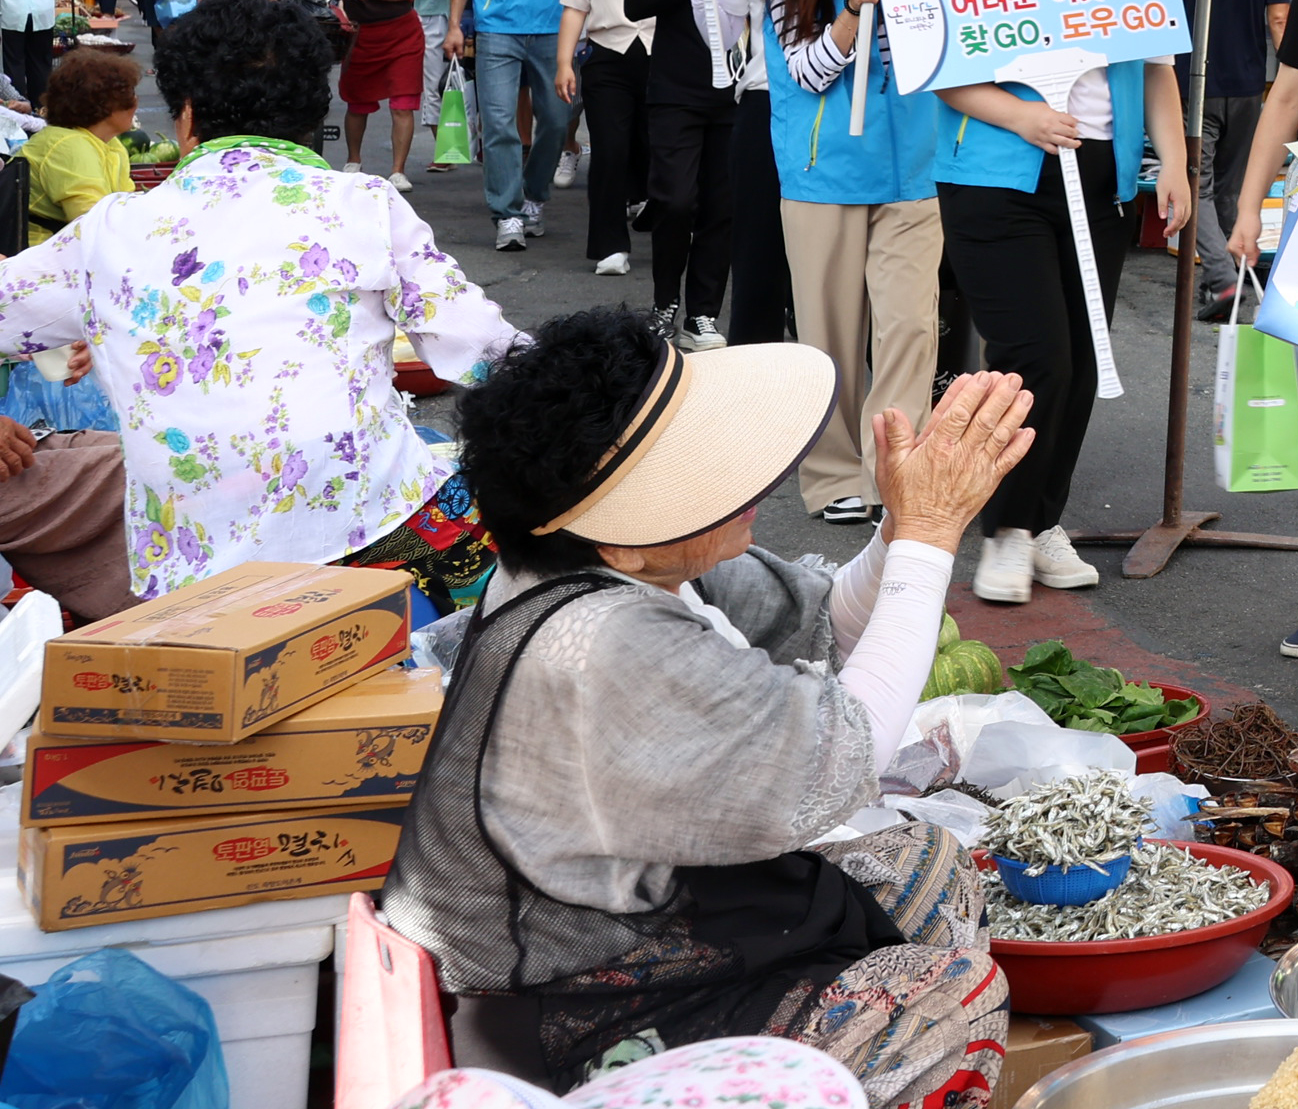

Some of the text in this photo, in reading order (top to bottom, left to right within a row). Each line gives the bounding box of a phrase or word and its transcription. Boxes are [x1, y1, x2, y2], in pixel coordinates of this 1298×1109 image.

[157, 768, 288, 794] 토판염 멸치
[217, 830, 340, 860] 토판염 멸치
